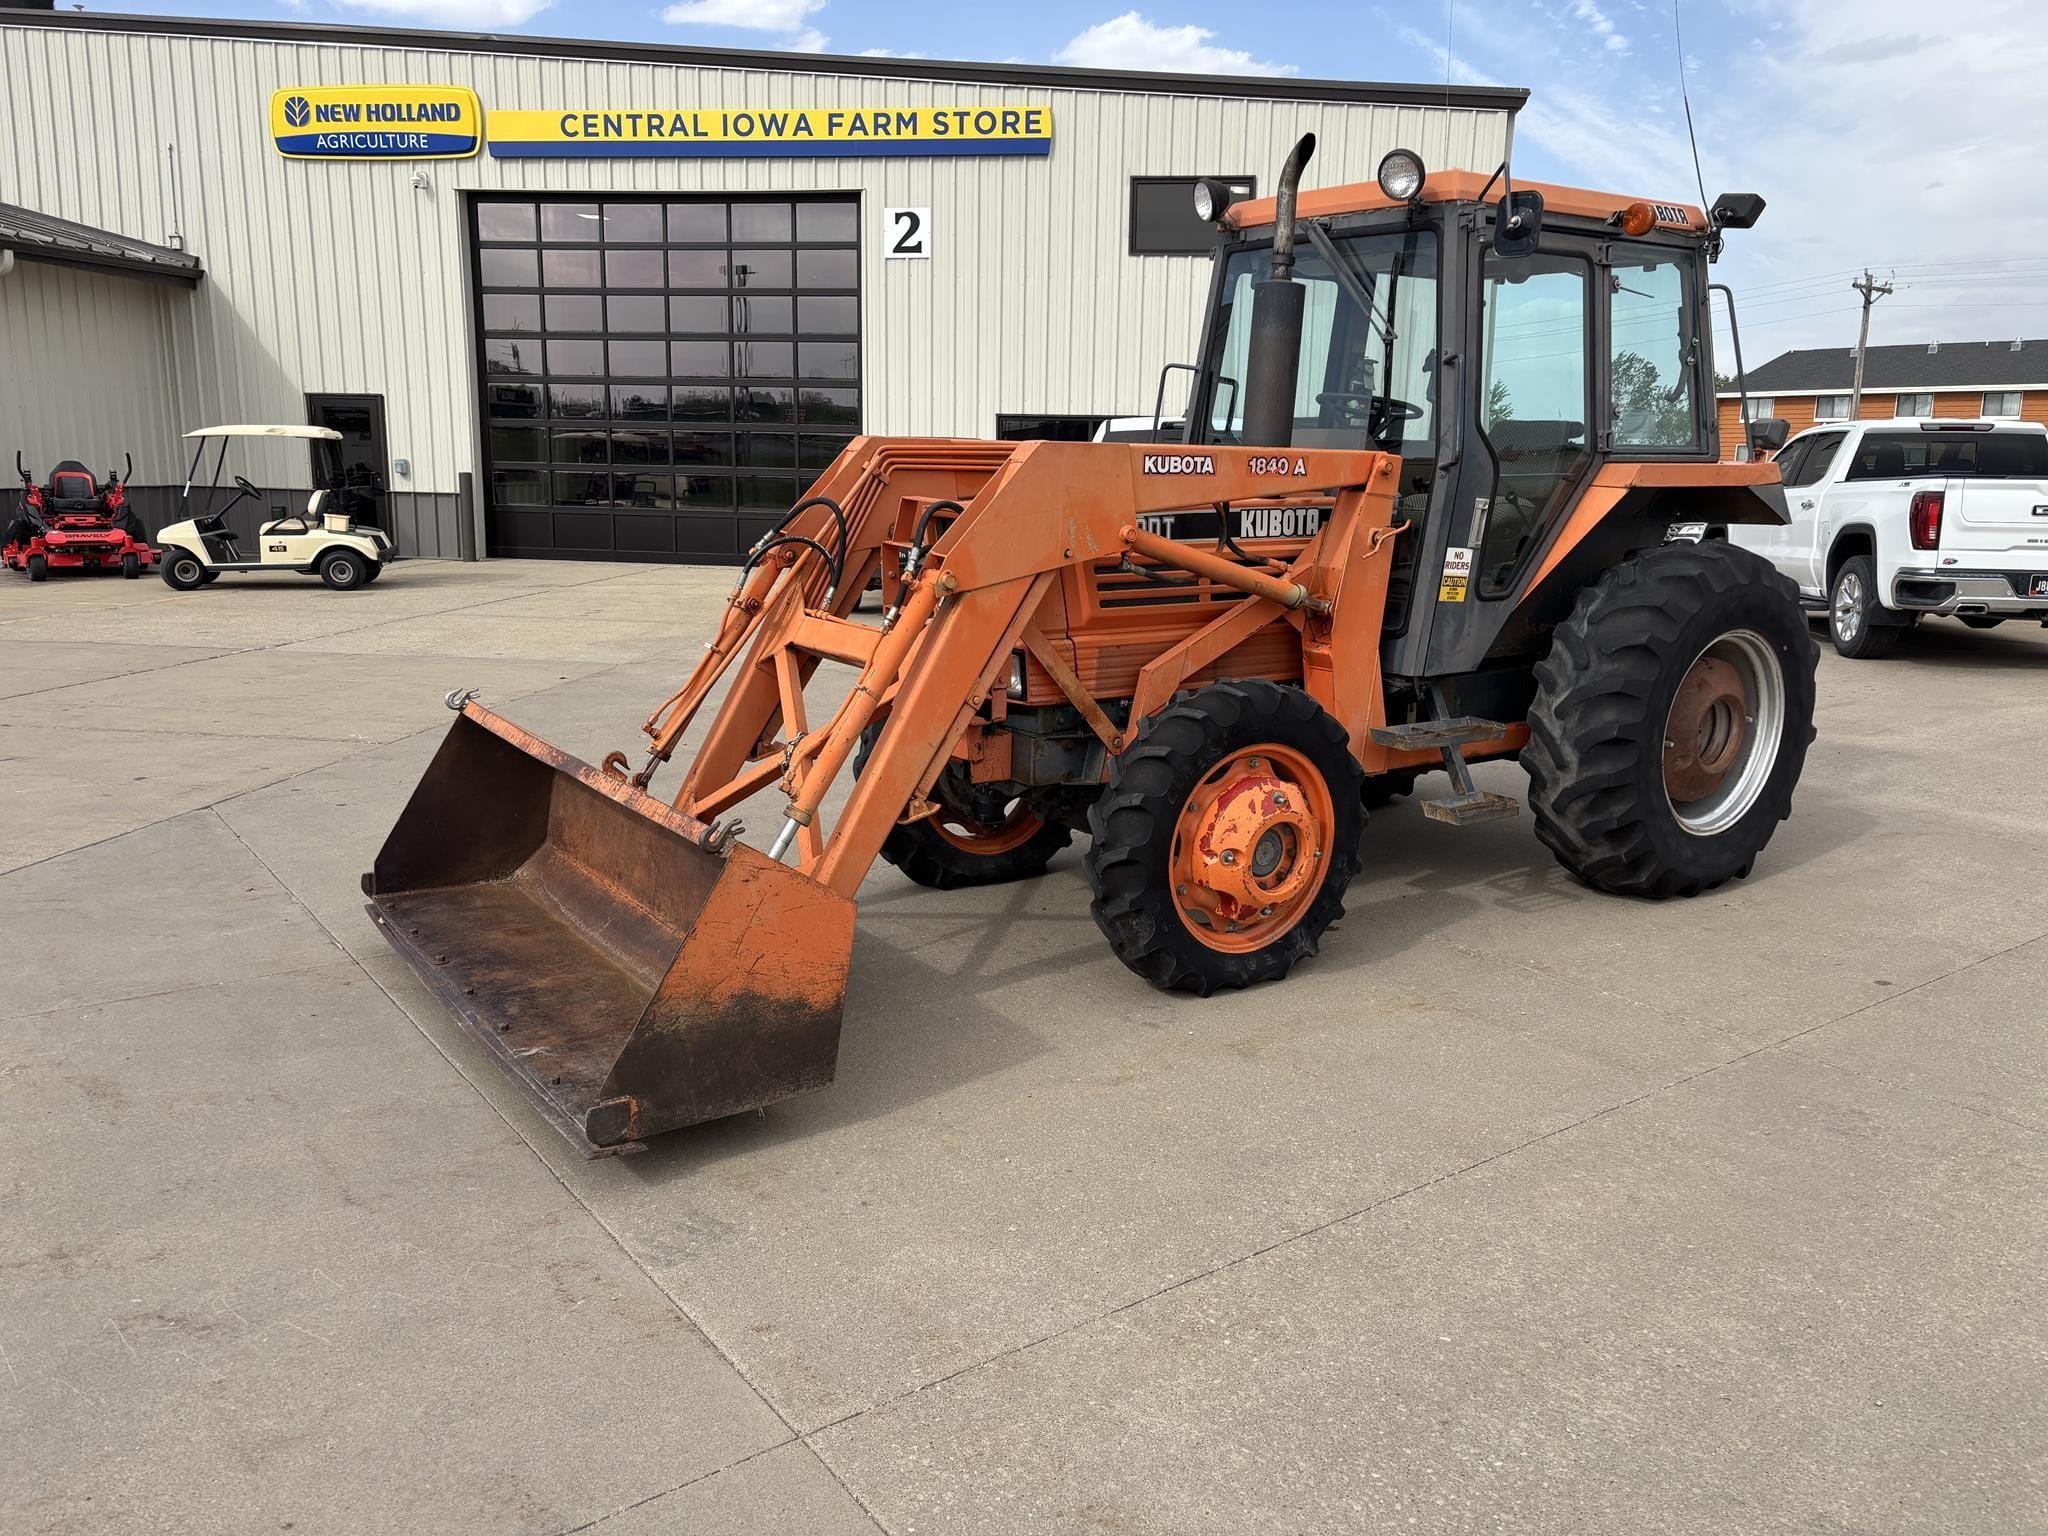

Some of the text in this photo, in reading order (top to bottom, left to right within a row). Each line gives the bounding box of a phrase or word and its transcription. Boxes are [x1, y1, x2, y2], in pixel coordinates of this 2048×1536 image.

[316, 103, 461, 122] NEW HOLLAND
[560, 110, 1043, 138] CENTRAL IOWA FARM STORE
[316, 134, 429, 149] AGRICULTURE
[892, 210, 923, 254] 2
[1143, 455, 1216, 475] KUBOTA
[1248, 457, 1307, 476] 1840 A
[1240, 509, 1320, 538] KUBOTA
[1454, 551, 1465, 560] NO
[1445, 561, 1470, 570] RIDERS
[1443, 576, 1467, 586] CAUTION
